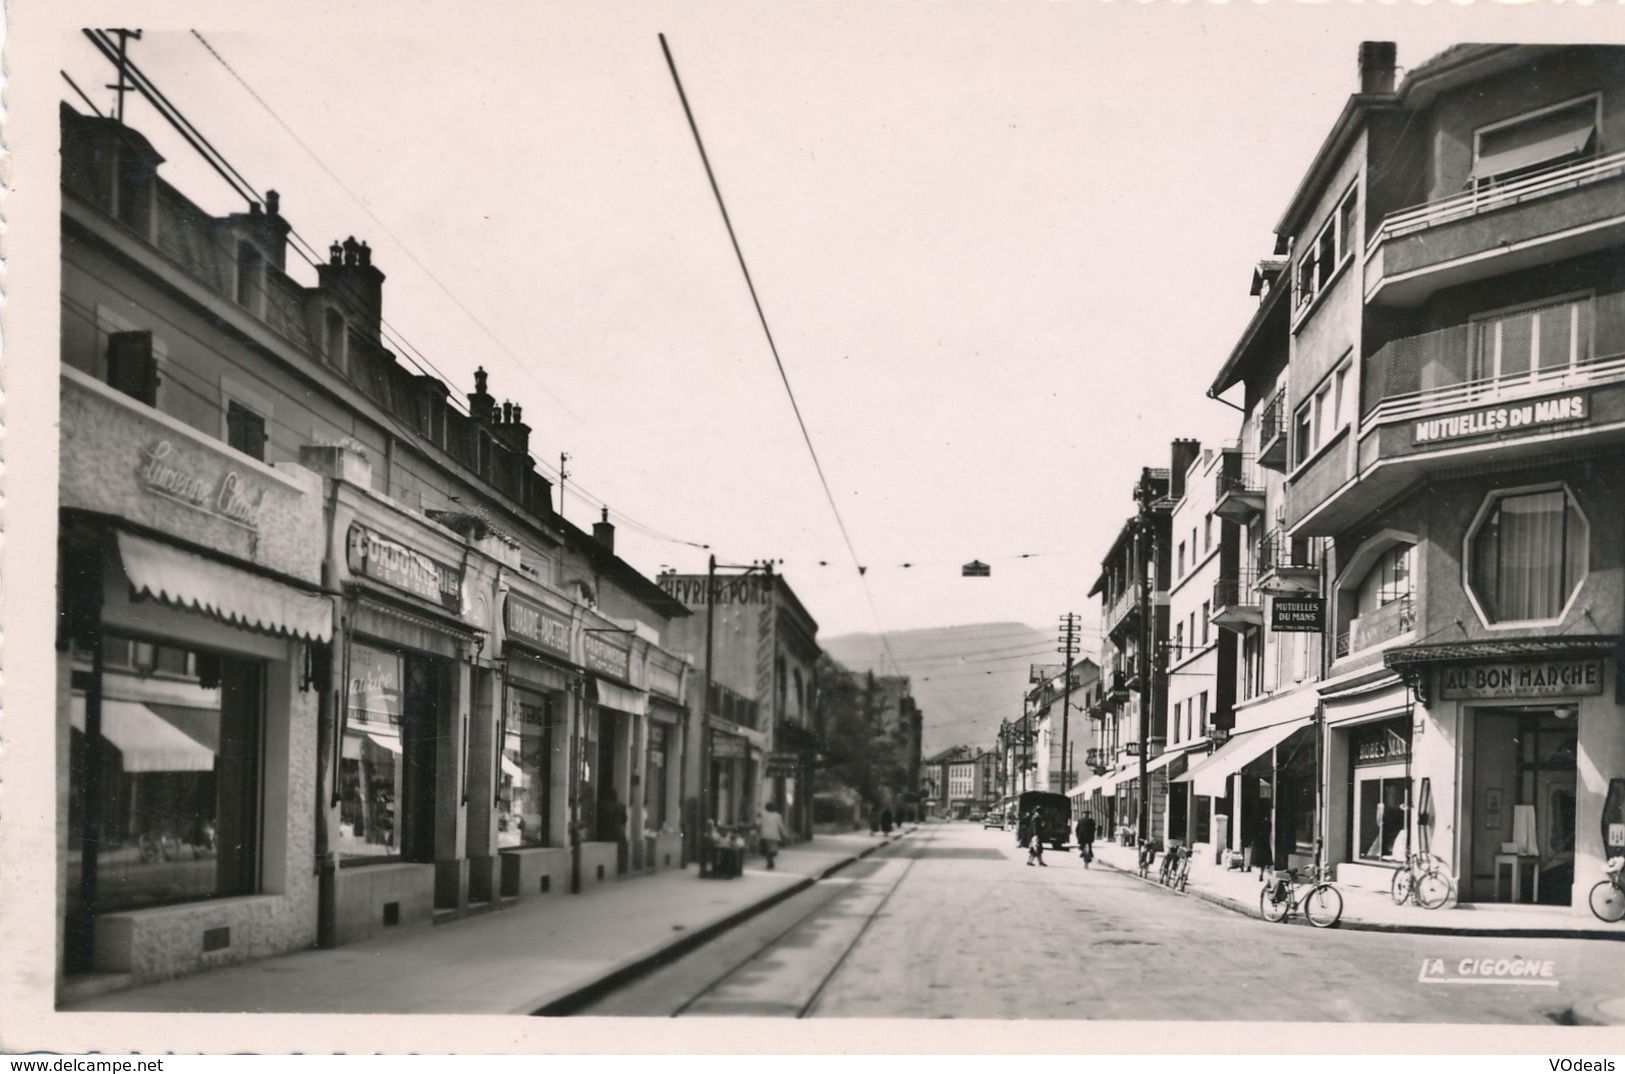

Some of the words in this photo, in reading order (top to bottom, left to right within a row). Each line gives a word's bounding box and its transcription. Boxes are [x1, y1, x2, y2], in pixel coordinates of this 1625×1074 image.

[1416, 408, 1507, 442] MUTUELLES
[1509, 405, 1532, 427] DU
[1534, 396, 1583, 423] MANS
[356, 530, 459, 598] CORDONNERIE
[1275, 602, 1319, 612] MUTUELLES
[1278, 612, 1291, 621] DU
[1292, 612, 1316, 621] MANS
[350, 664, 393, 696] aurice
[1446, 671, 1469, 690] AU
[1475, 668, 1513, 689] BON
[1519, 664, 1597, 688] MARCHE
[1360, 742, 1385, 760] ROBES
